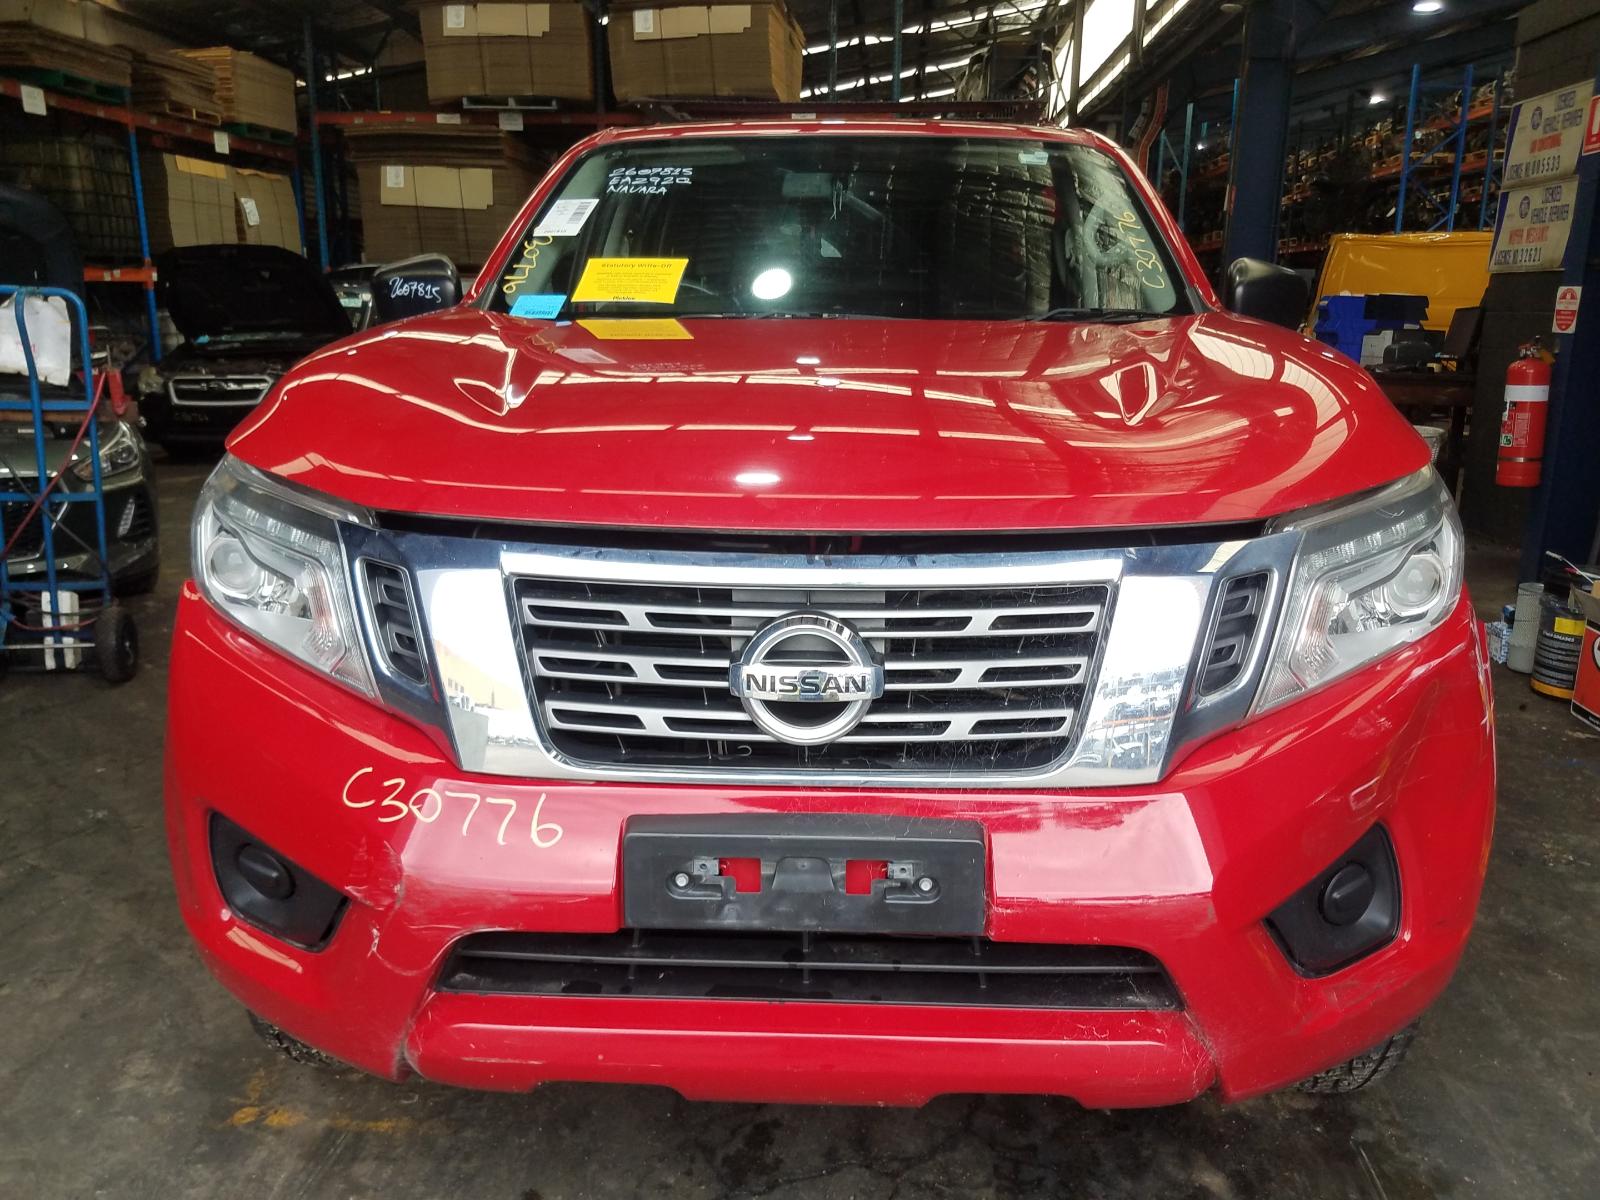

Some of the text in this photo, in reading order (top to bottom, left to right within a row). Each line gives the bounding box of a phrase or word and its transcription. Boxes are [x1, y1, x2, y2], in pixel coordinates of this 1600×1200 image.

[608, 167, 693, 177] 2607815
[606, 185, 668, 196] NAVARA
[1113, 211, 1165, 289] C30776
[389, 277, 442, 304] 2607815
[745, 673, 867, 694] NISSAN
[342, 766, 564, 848] C30776
